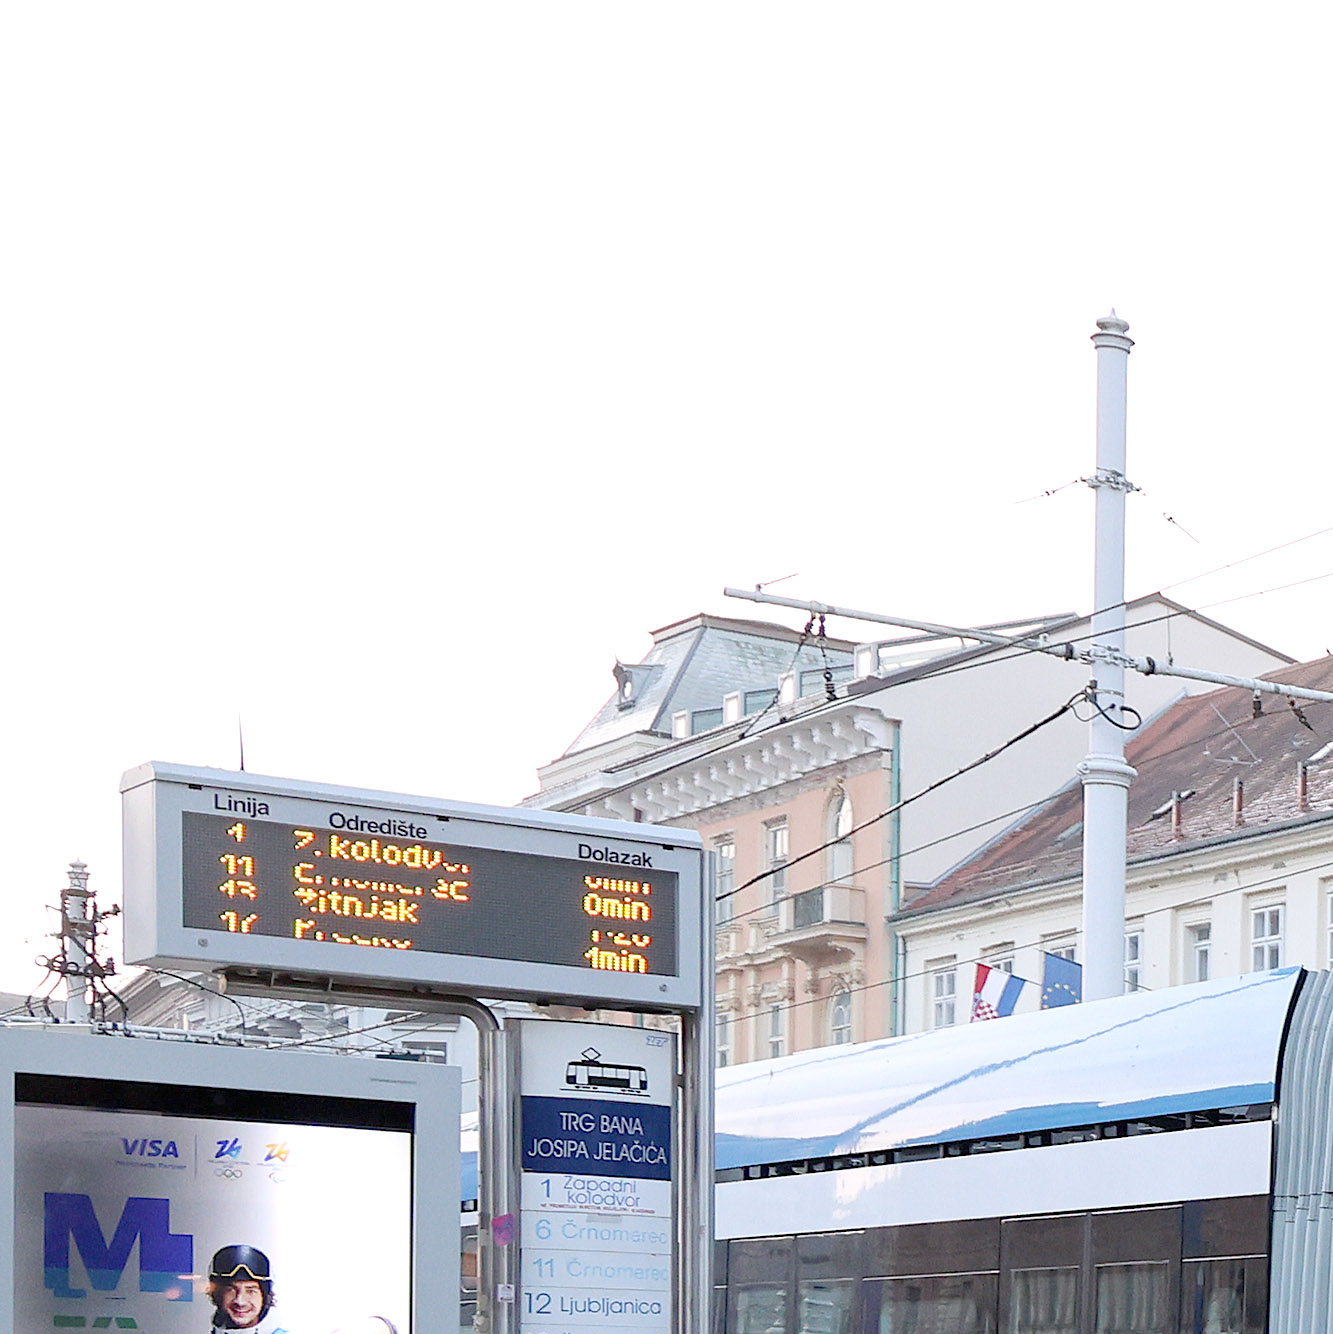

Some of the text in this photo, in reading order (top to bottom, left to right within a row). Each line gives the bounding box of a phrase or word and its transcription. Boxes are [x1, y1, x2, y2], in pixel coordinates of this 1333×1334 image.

[214, 793, 270, 818] Linija
[329, 812, 428, 839] Odredište
[578, 843, 653, 868] Dolazak
[219, 854, 652, 921] 11 0min
[583, 946, 649, 974] 1min
[560, 1112, 643, 1135] TRG BANA
[121, 1138, 179, 1158] VISA
[528, 1138, 667, 1165] JOSIPA JELAČIĆA
[541, 1175, 637, 1198] 1 Zapadni
[567, 1189, 641, 1208] kolodvor
[535, 1218, 668, 1246] 6 Črnomerec
[533, 1258, 555, 1279] 11
[524, 1292, 662, 1317] 12 Ljubljanica
